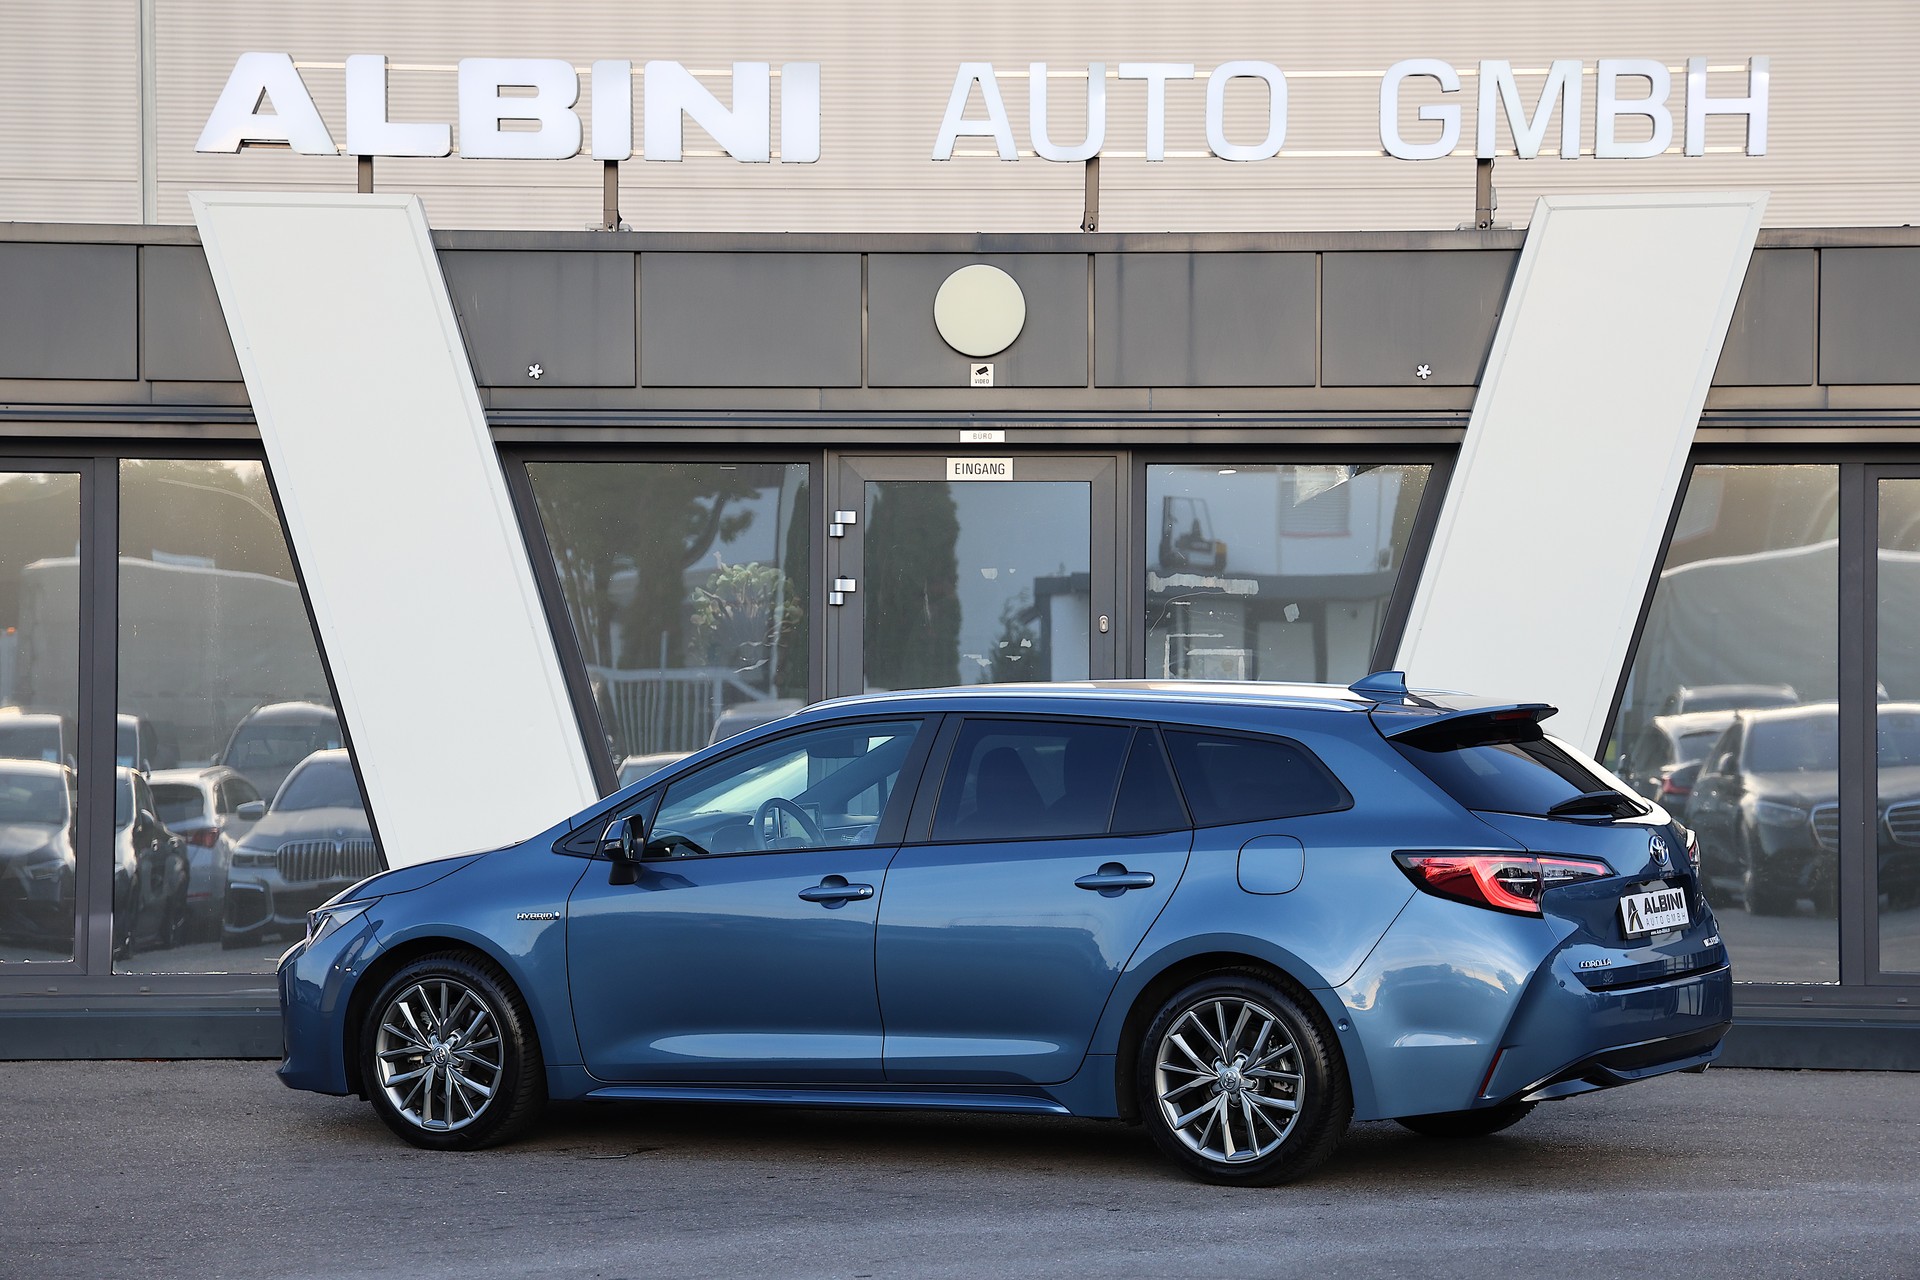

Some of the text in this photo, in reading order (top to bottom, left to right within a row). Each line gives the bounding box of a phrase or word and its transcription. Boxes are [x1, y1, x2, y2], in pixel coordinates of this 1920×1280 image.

[194, 51, 1771, 163] ALBINI AUTO GMBH
[954, 462, 1006, 476] EINGANG
[1644, 891, 1684, 915] ALBINI
[516, 912, 553, 920] HYBRID
[1645, 911, 1687, 927] AUTO GMBH
[1579, 957, 1612, 968] COROLLA
